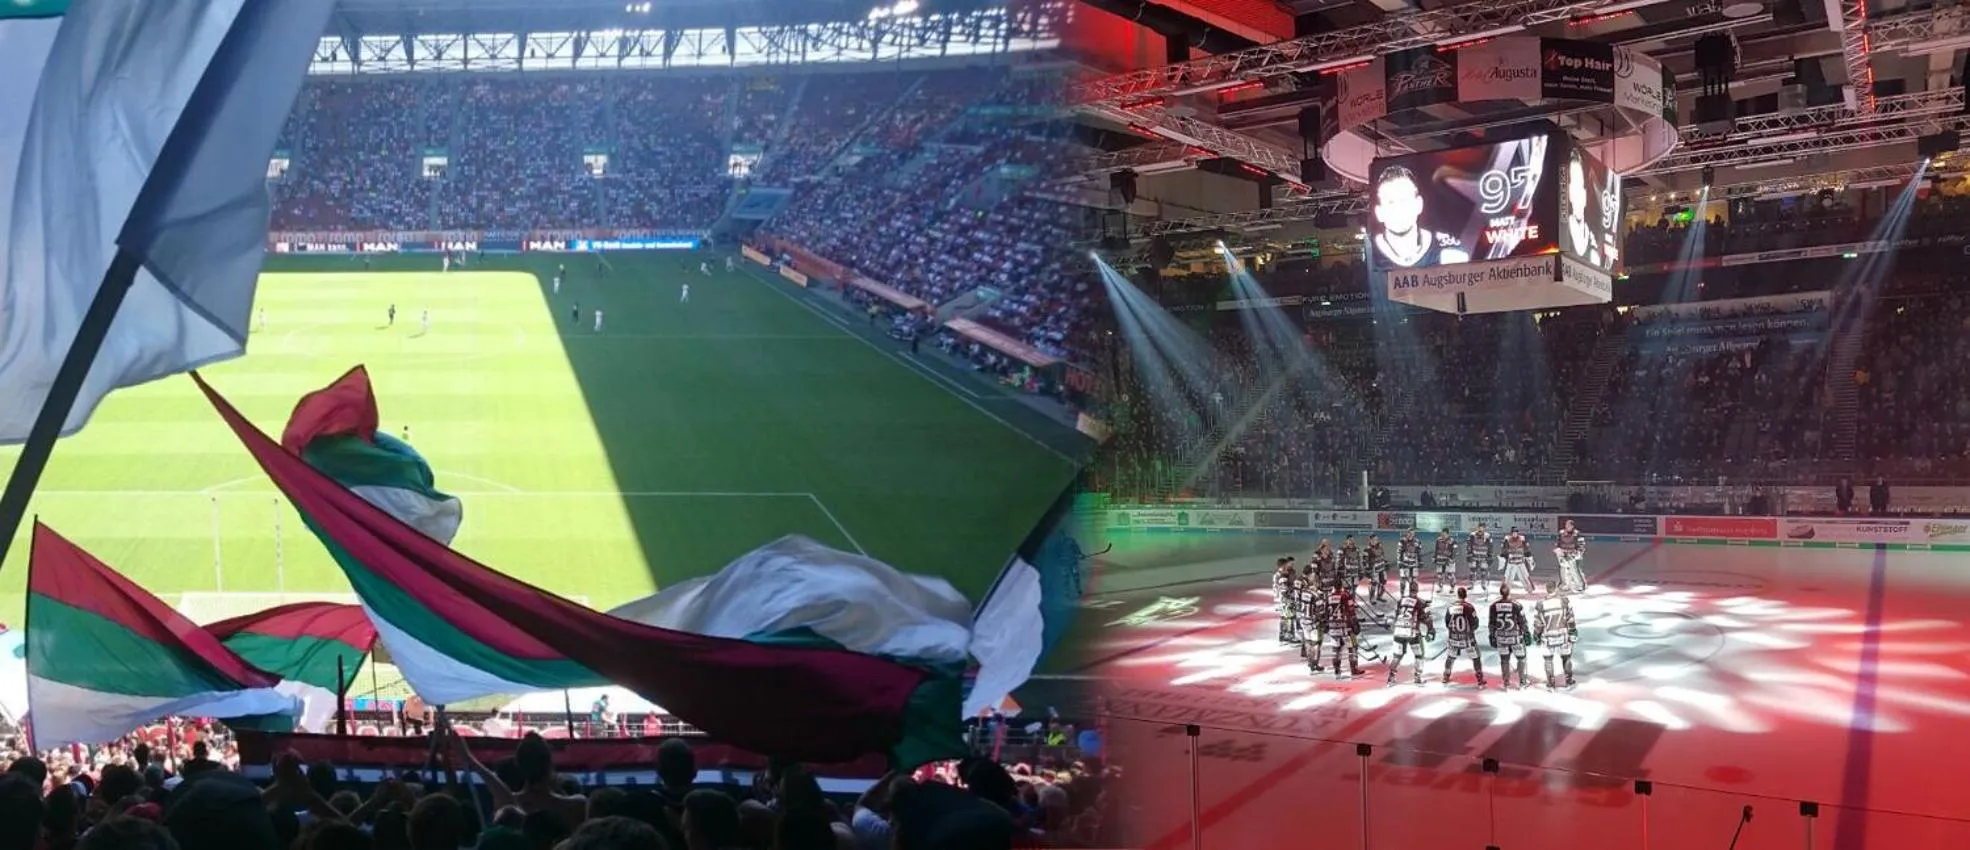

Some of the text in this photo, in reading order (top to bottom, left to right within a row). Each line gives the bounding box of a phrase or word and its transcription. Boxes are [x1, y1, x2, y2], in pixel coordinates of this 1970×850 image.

[1558, 55, 1612, 70] Top Hair
[1489, 66, 1537, 82] Augusta
[1480, 167, 1537, 213] 97
[1485, 225, 1538, 243] WHITE
[364, 242, 398, 252] MAN
[529, 240, 565, 251] MAN
[1393, 260, 1552, 290] AAB Augsburger Aktienbank
[1448, 616, 1466, 632] 40
[1496, 613, 1515, 630] 55
[1544, 611, 1562, 629] 77
